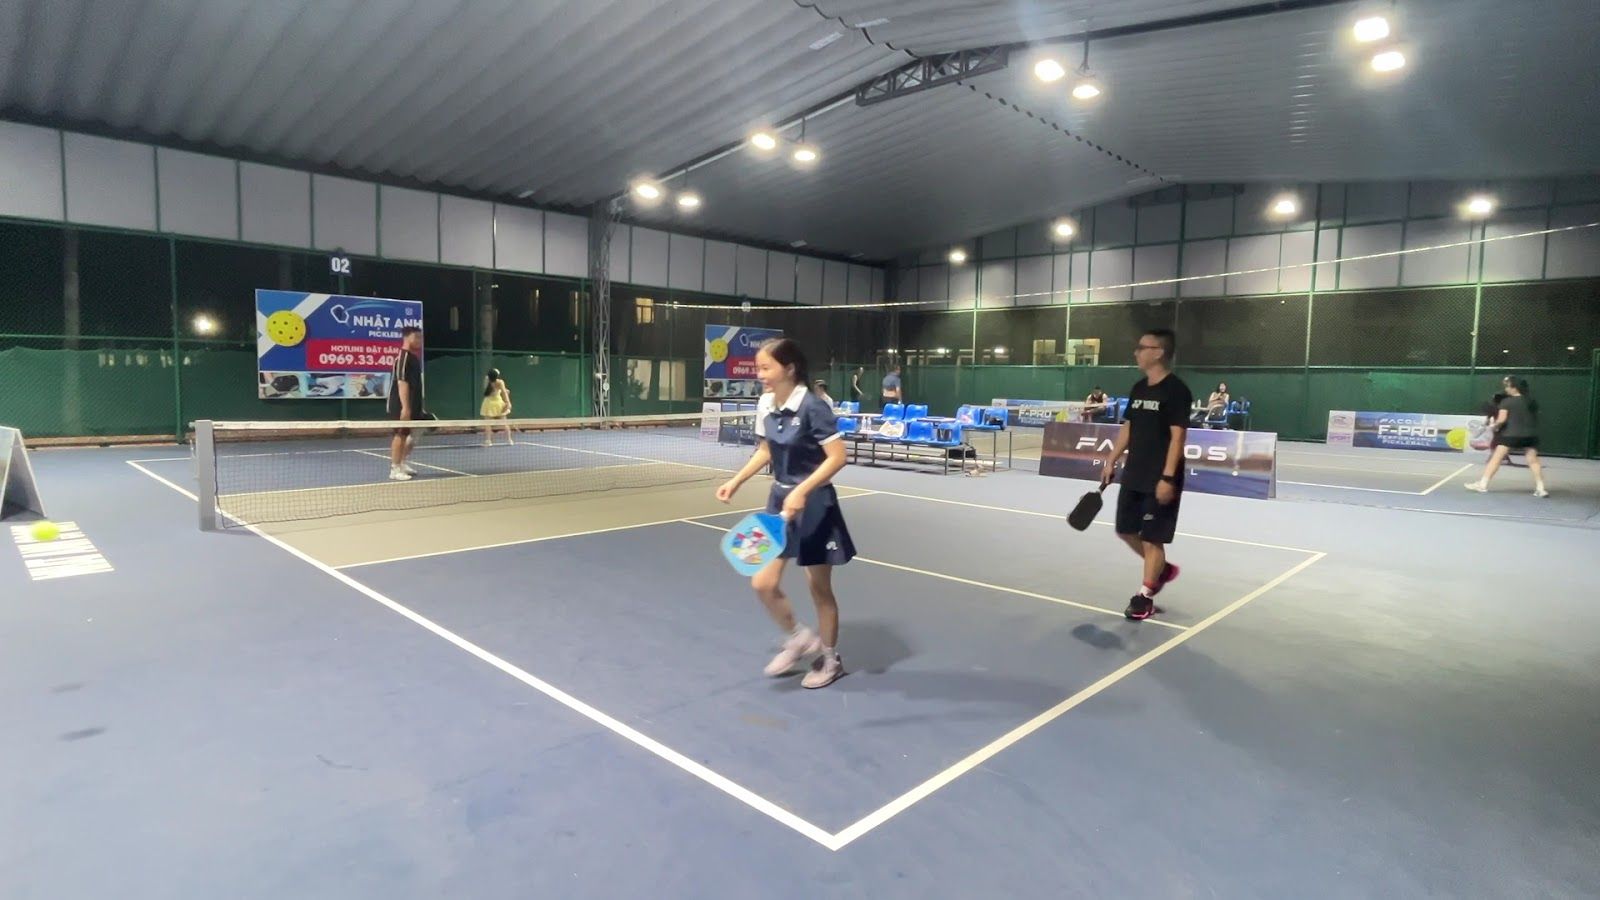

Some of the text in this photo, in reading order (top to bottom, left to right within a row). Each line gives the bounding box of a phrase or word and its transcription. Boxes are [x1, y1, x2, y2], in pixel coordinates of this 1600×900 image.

[331, 257, 350, 273] 02
[353, 314, 422, 330] NHẬT ANH
[331, 345, 364, 353] HOTLINE
[319, 353, 400, 365] 0969.33.40
[1378, 424, 1438, 438] F-PRO
